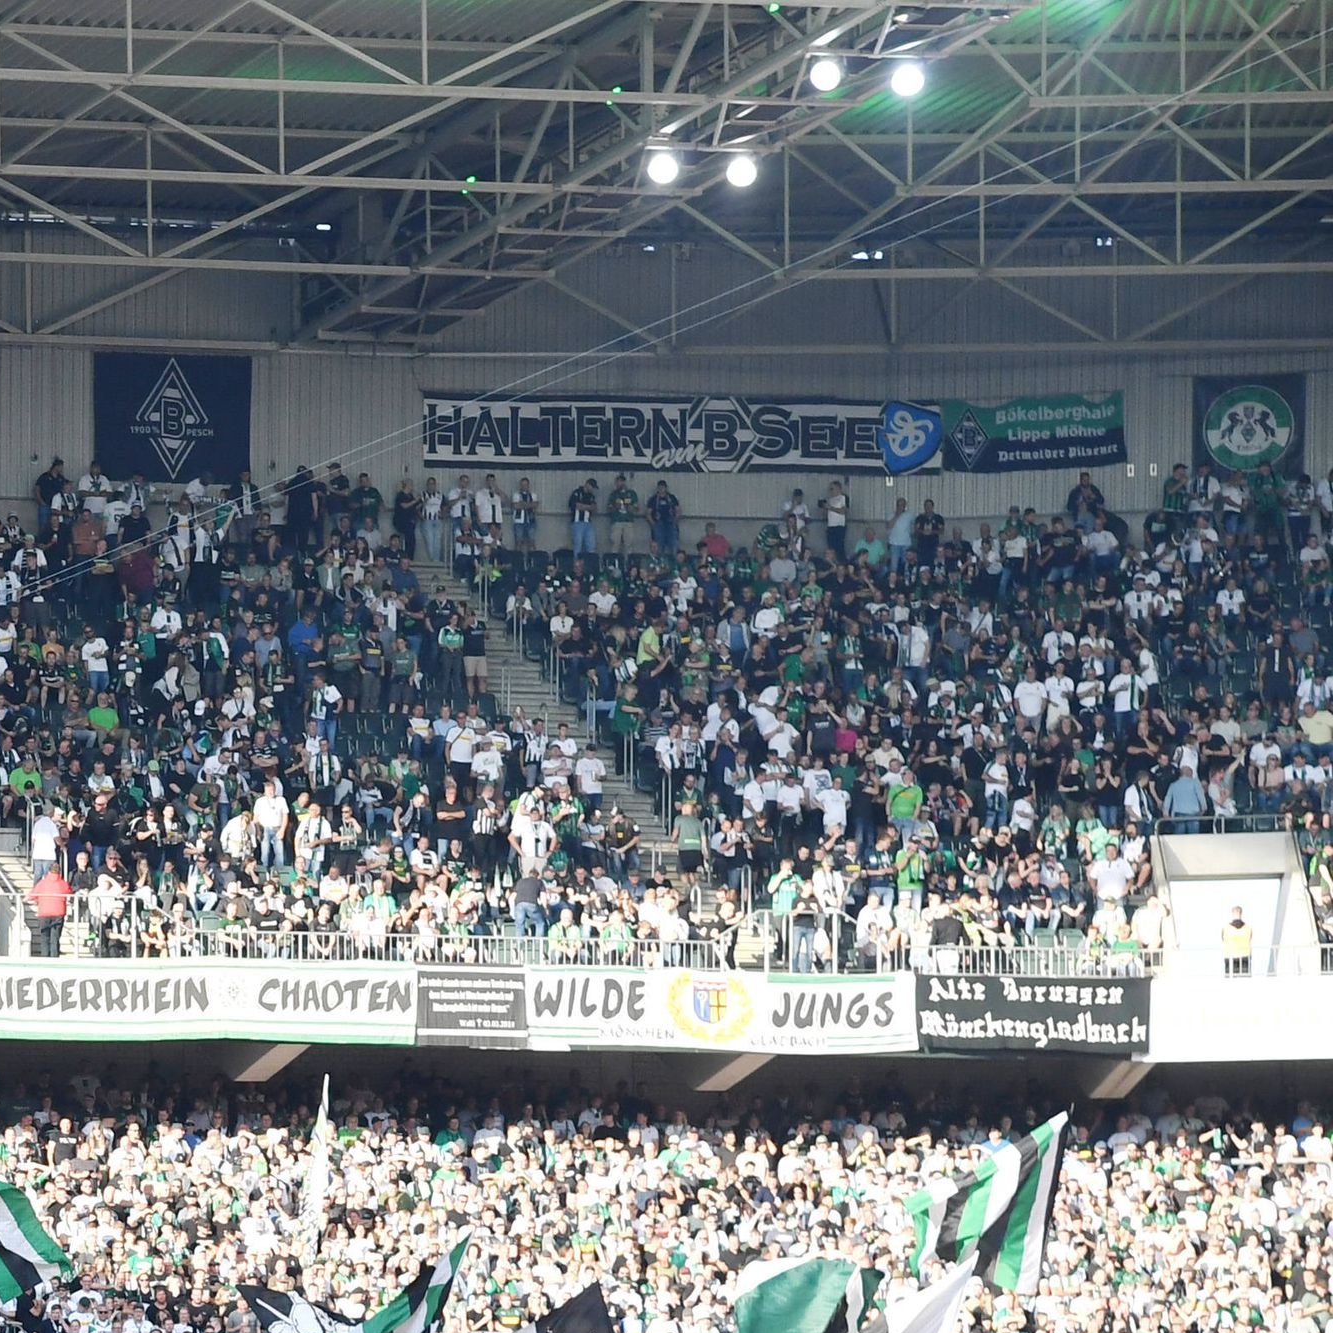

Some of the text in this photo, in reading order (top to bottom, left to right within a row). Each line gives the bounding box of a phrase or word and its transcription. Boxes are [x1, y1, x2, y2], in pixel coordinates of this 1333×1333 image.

[186, 428, 214, 437] PESCH
[426, 404, 688, 459] HALTERN
[651, 442, 709, 469] am
[749, 405, 886, 461] SEE
[1008, 425, 1107, 442] Lippe Möhne
[258, 977, 412, 1013] CHAOTEN
[534, 977, 895, 1029] WILDE JUNGS
[929, 977, 1124, 1007] Alte Borussen
[919, 1010, 1147, 1049] Mönchengladbach
